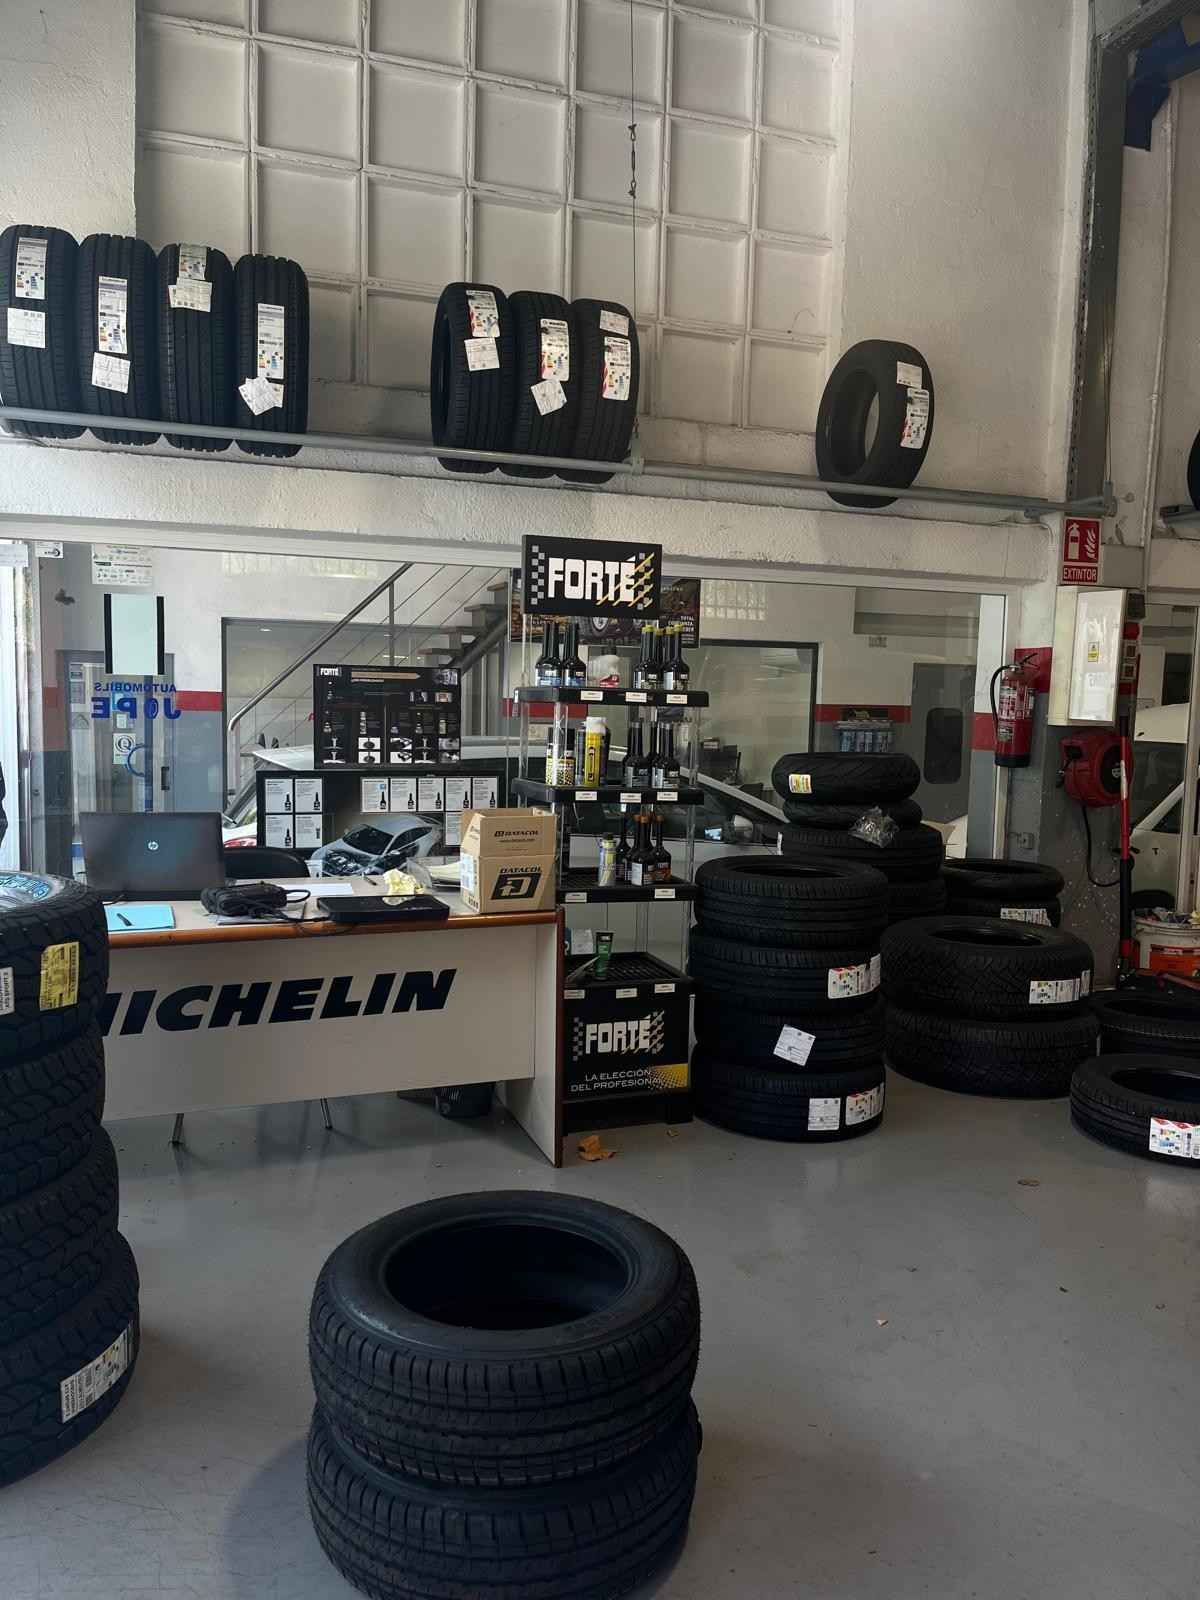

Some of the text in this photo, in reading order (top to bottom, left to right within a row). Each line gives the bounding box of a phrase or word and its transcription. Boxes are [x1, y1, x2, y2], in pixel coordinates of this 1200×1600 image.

[1063, 567, 1097, 582] EXTINTOR
[500, 865, 542, 874] DATACOL
[585, 1073, 598, 1082] LA
[570, 1083, 592, 1092] DEL
